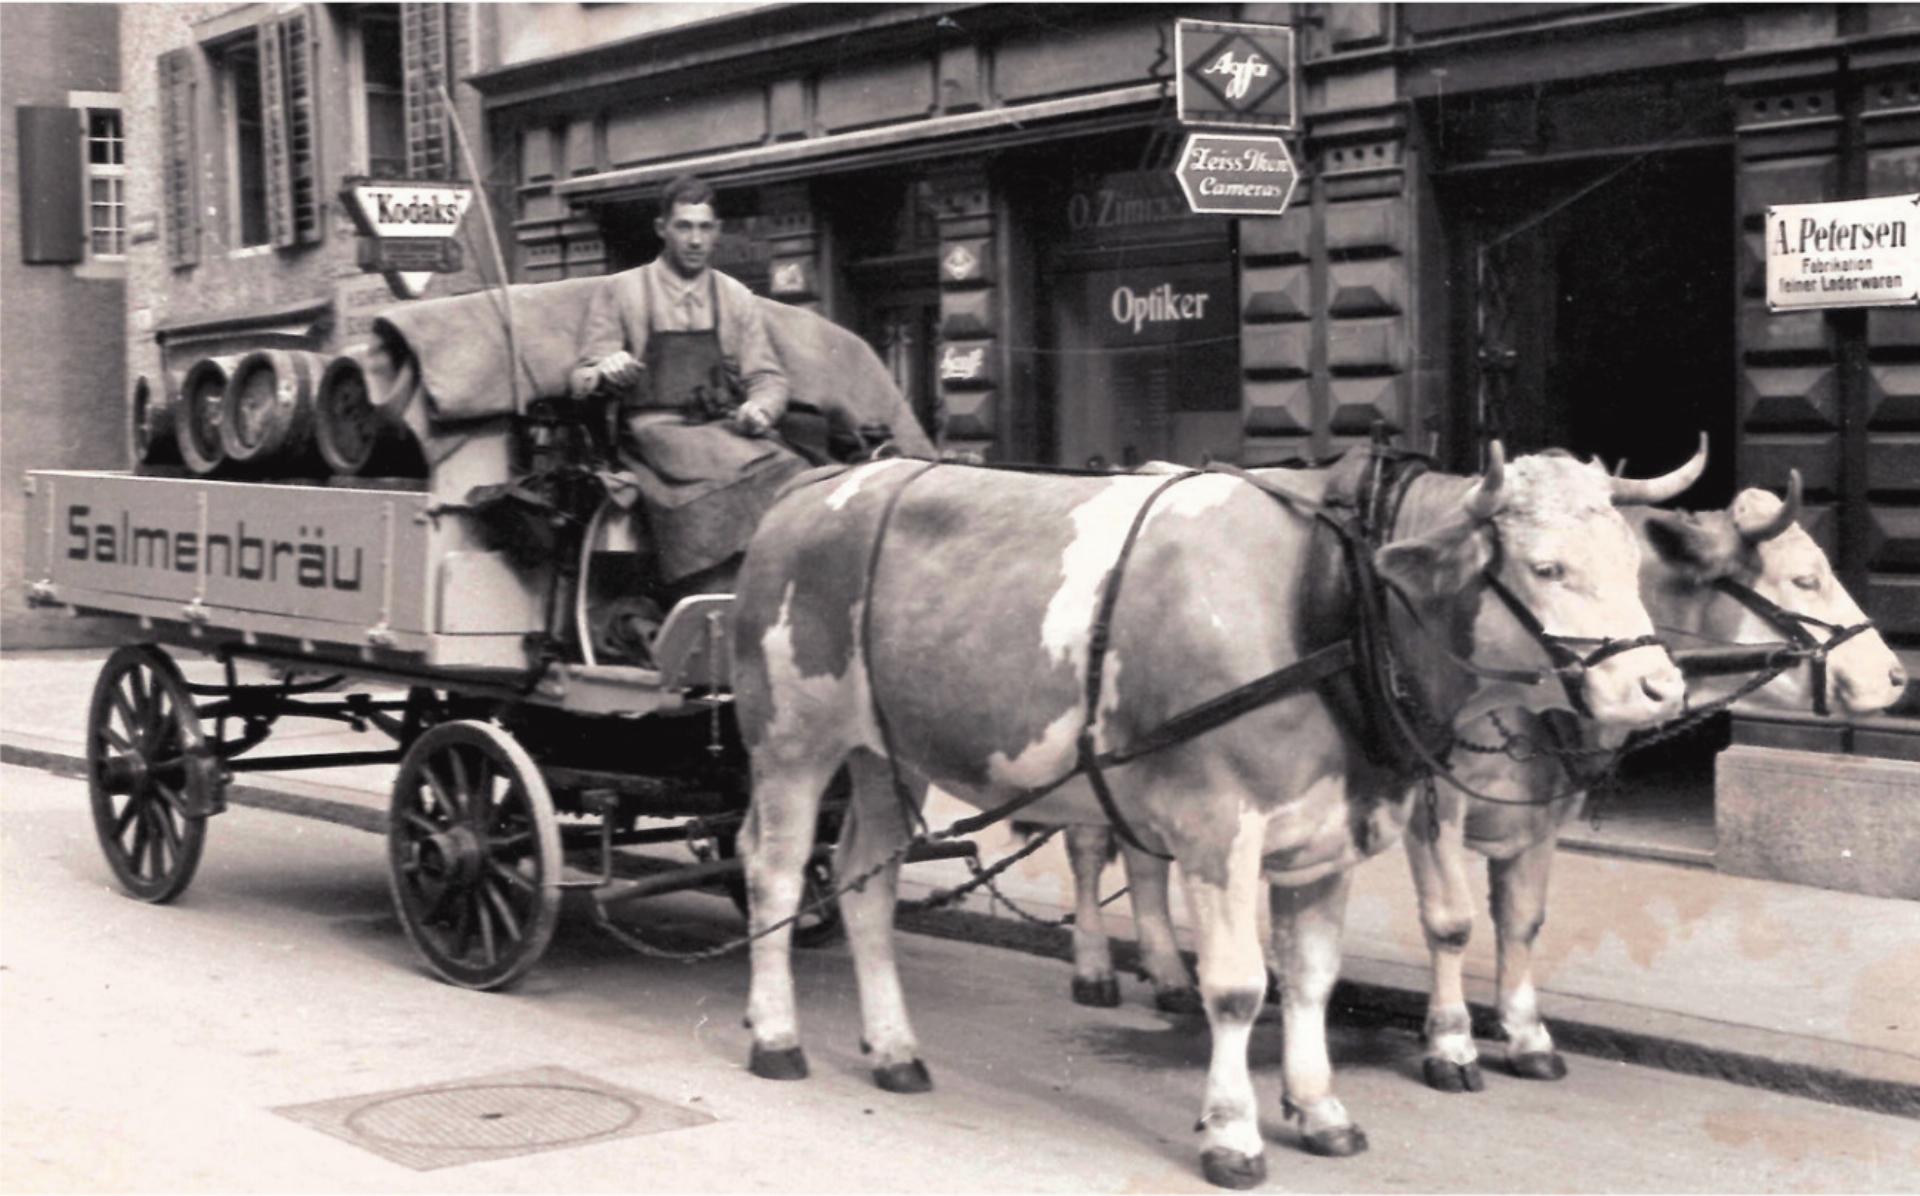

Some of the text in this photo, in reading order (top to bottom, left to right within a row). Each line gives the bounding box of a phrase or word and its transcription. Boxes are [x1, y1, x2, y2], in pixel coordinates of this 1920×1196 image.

[1204, 51, 1270, 99] Agfa
[1190, 147, 1242, 171] Zeiss
[1199, 176, 1281, 196] Cameras
[1801, 257, 1873, 274] Fabrikation
[1820, 274, 1903, 292] Lederwaren
[1111, 282, 1210, 335] Optiker
[67, 504, 364, 592] Salmenbräu
